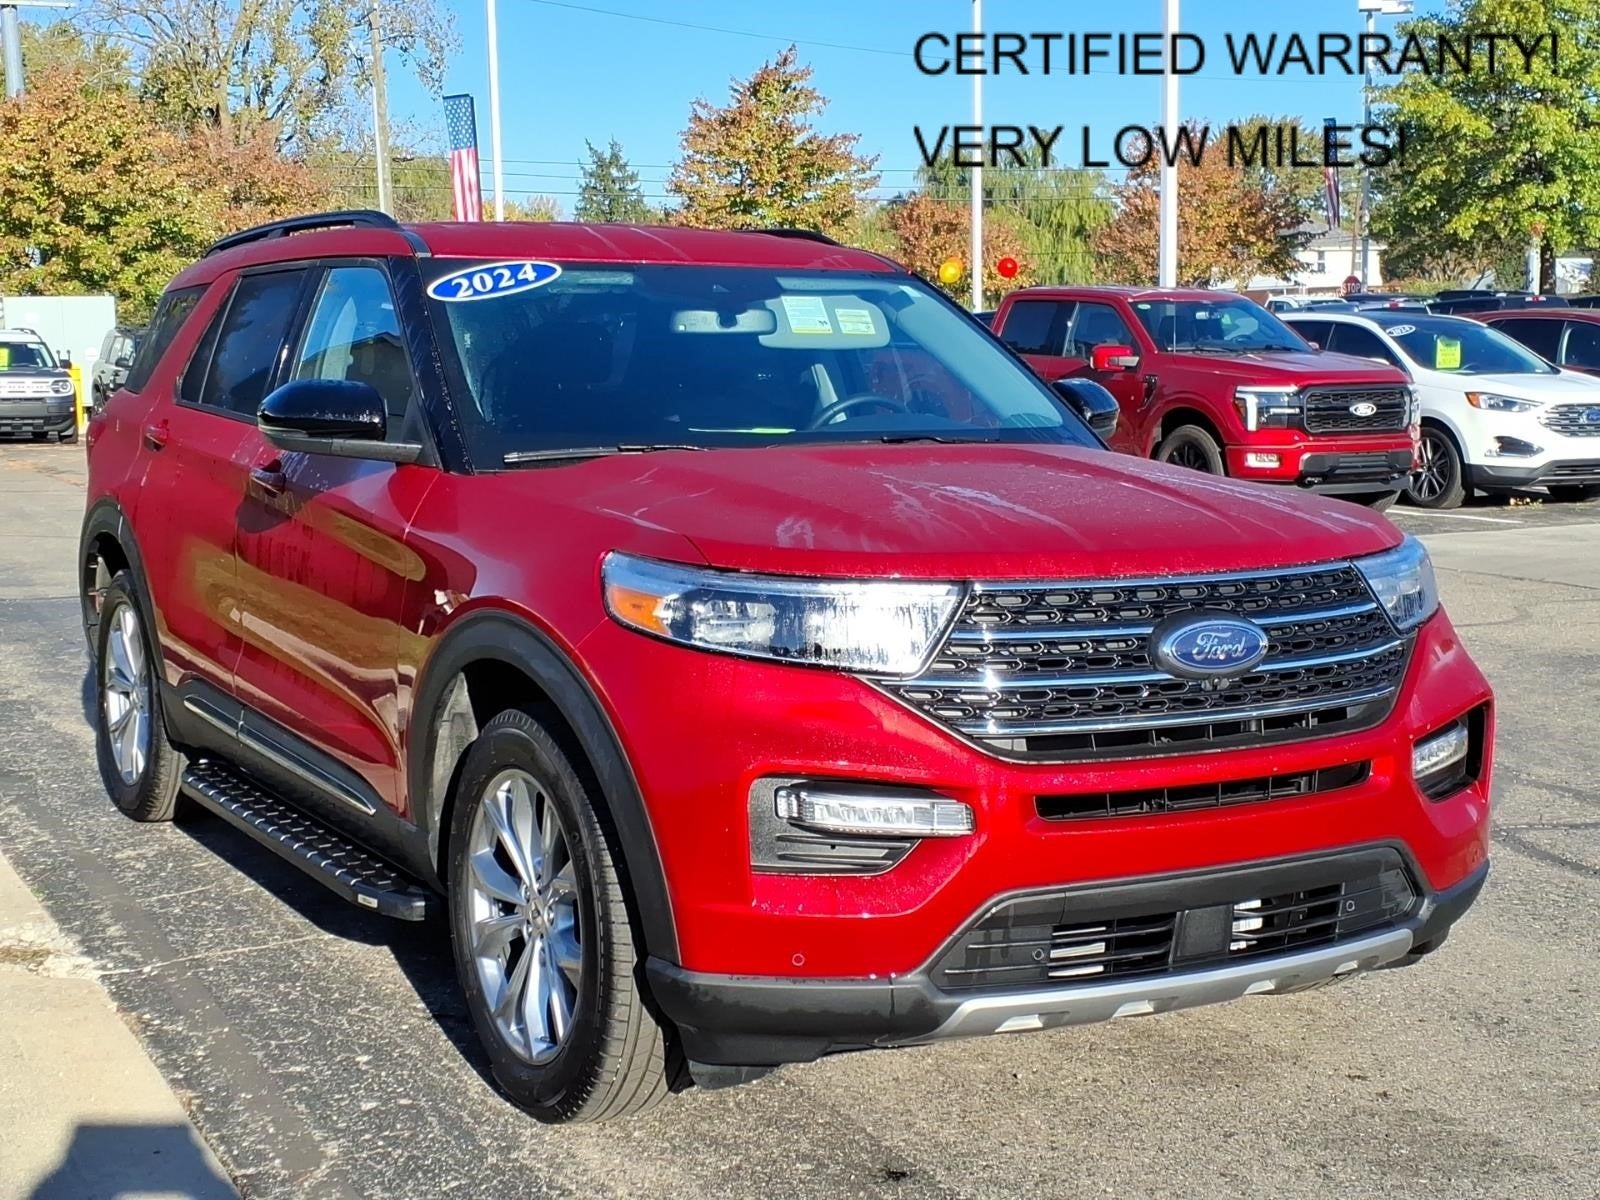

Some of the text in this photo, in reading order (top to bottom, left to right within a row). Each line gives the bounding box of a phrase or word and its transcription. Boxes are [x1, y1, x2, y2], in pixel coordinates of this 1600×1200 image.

[451, 263, 537, 298] 2024
[1342, 282, 1361, 294] STOP
[1192, 631, 1247, 660] Ford
